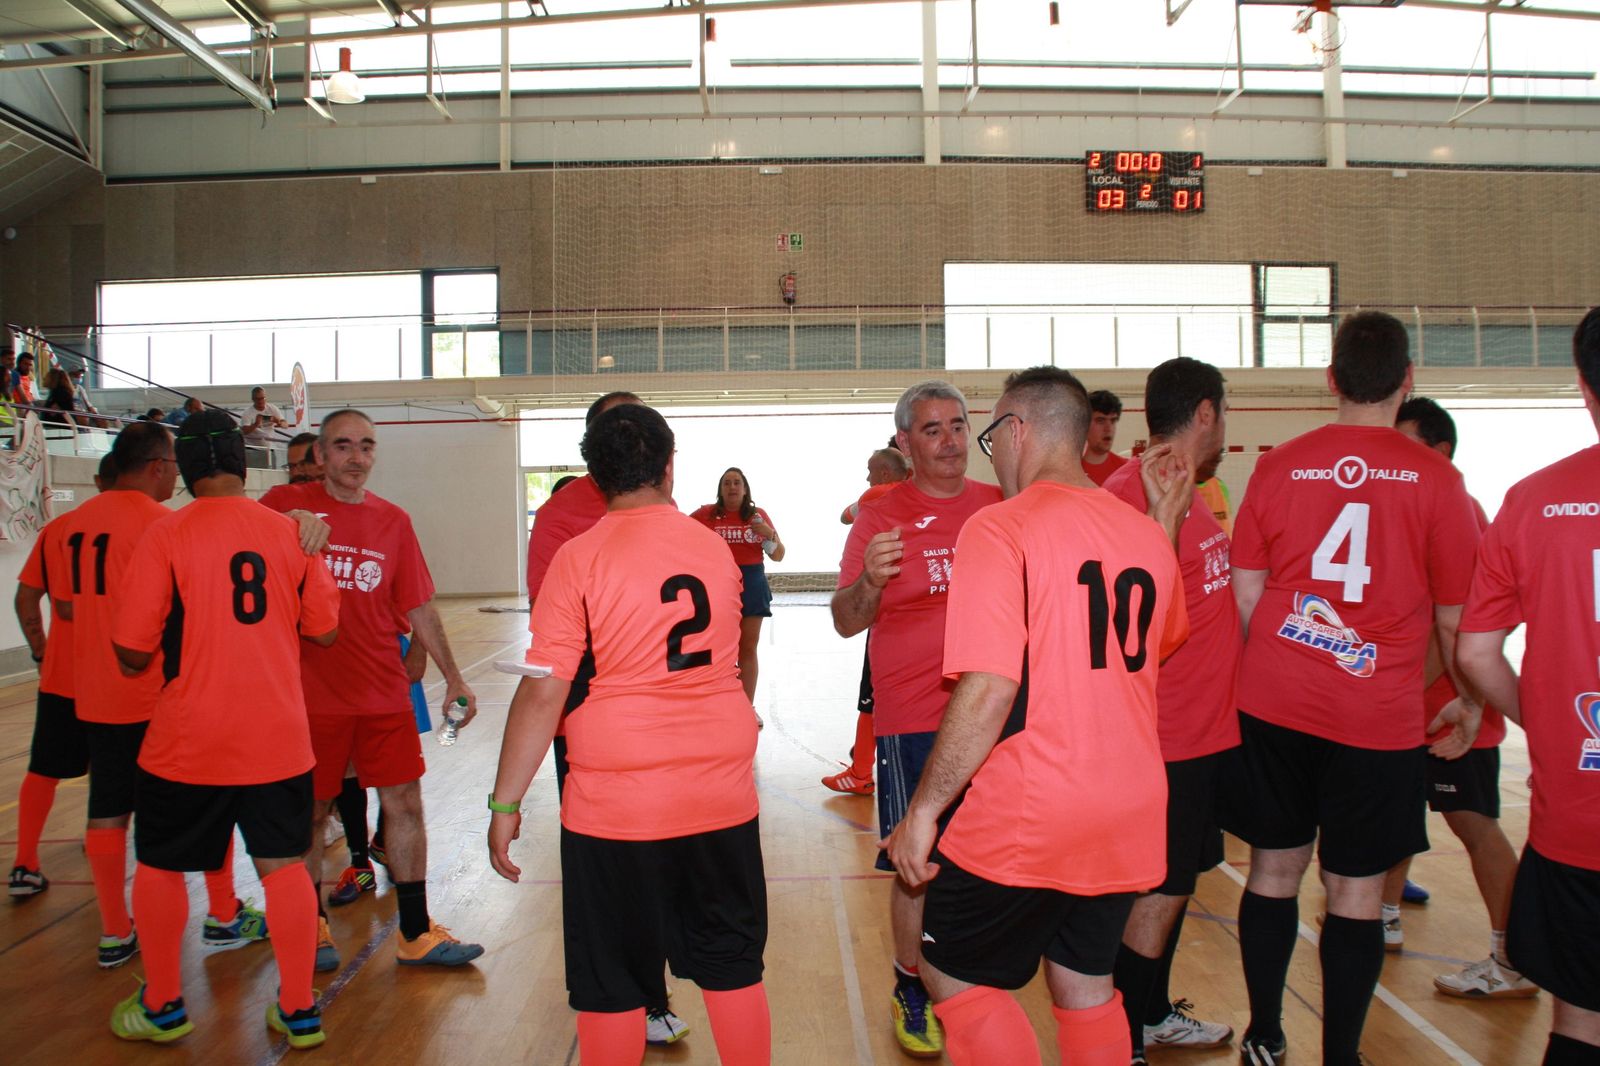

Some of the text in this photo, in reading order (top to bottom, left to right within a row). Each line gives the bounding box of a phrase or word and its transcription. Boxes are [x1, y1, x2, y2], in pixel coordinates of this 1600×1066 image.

[1089, 152, 1101, 168] 2
[1193, 154, 1202, 168] 1
[1092, 175, 1124, 185] LOCAL
[1169, 176, 1200, 185] VISITANTE
[1098, 189, 1126, 209] 03
[1141, 184, 1152, 199] 2
[1174, 190, 1202, 209] 01
[1291, 468, 1333, 480] OVIDIO
[1368, 468, 1420, 483] TALLER
[1543, 502, 1600, 518] OVIDIO
[361, 548, 385, 560] BURGOS
[923, 548, 949, 557] SALUD
[1311, 502, 1371, 603] 4
[67, 532, 111, 595] 11
[229, 551, 267, 625] 8
[660, 574, 712, 672] 2
[1077, 560, 1156, 673] 10
[1287, 614, 1344, 639] AUTOCARES
